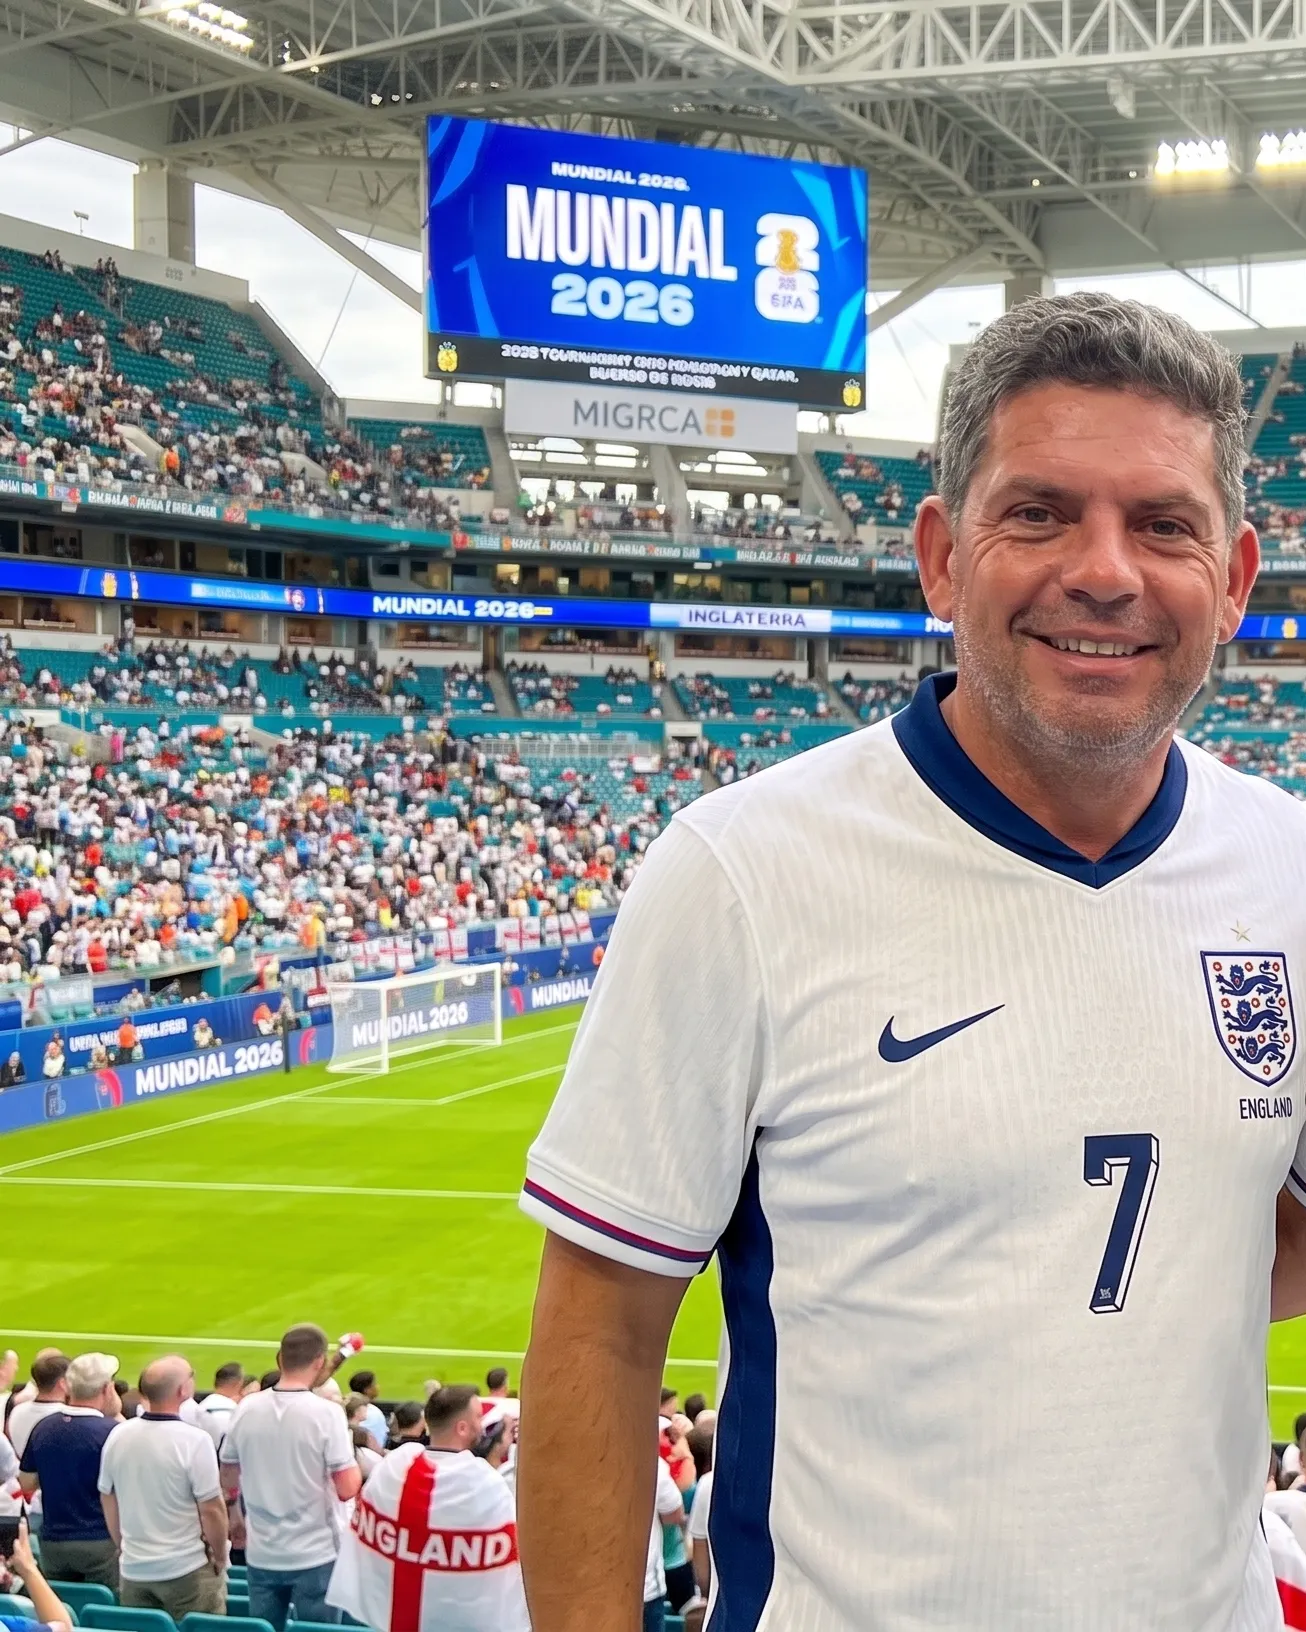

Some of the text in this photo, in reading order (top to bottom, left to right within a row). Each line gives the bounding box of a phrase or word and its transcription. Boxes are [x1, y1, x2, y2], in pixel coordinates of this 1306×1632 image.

[551, 161, 637, 185] MUNDIAL
[505, 183, 738, 281] MUNDIAL
[550, 273, 694, 327] 2026
[573, 398, 703, 435] MIGRCA
[373, 596, 535, 619] MUNDIAL 2026
[688, 608, 807, 628] INGLATERRA
[531, 977, 592, 1008] MUNDIAL
[429, 1001, 468, 1030] 2026
[135, 1040, 284, 1096] MUNDIAL 2026
[1239, 1097, 1293, 1119] ENGLAND
[1084, 1133, 1160, 1314] 7
